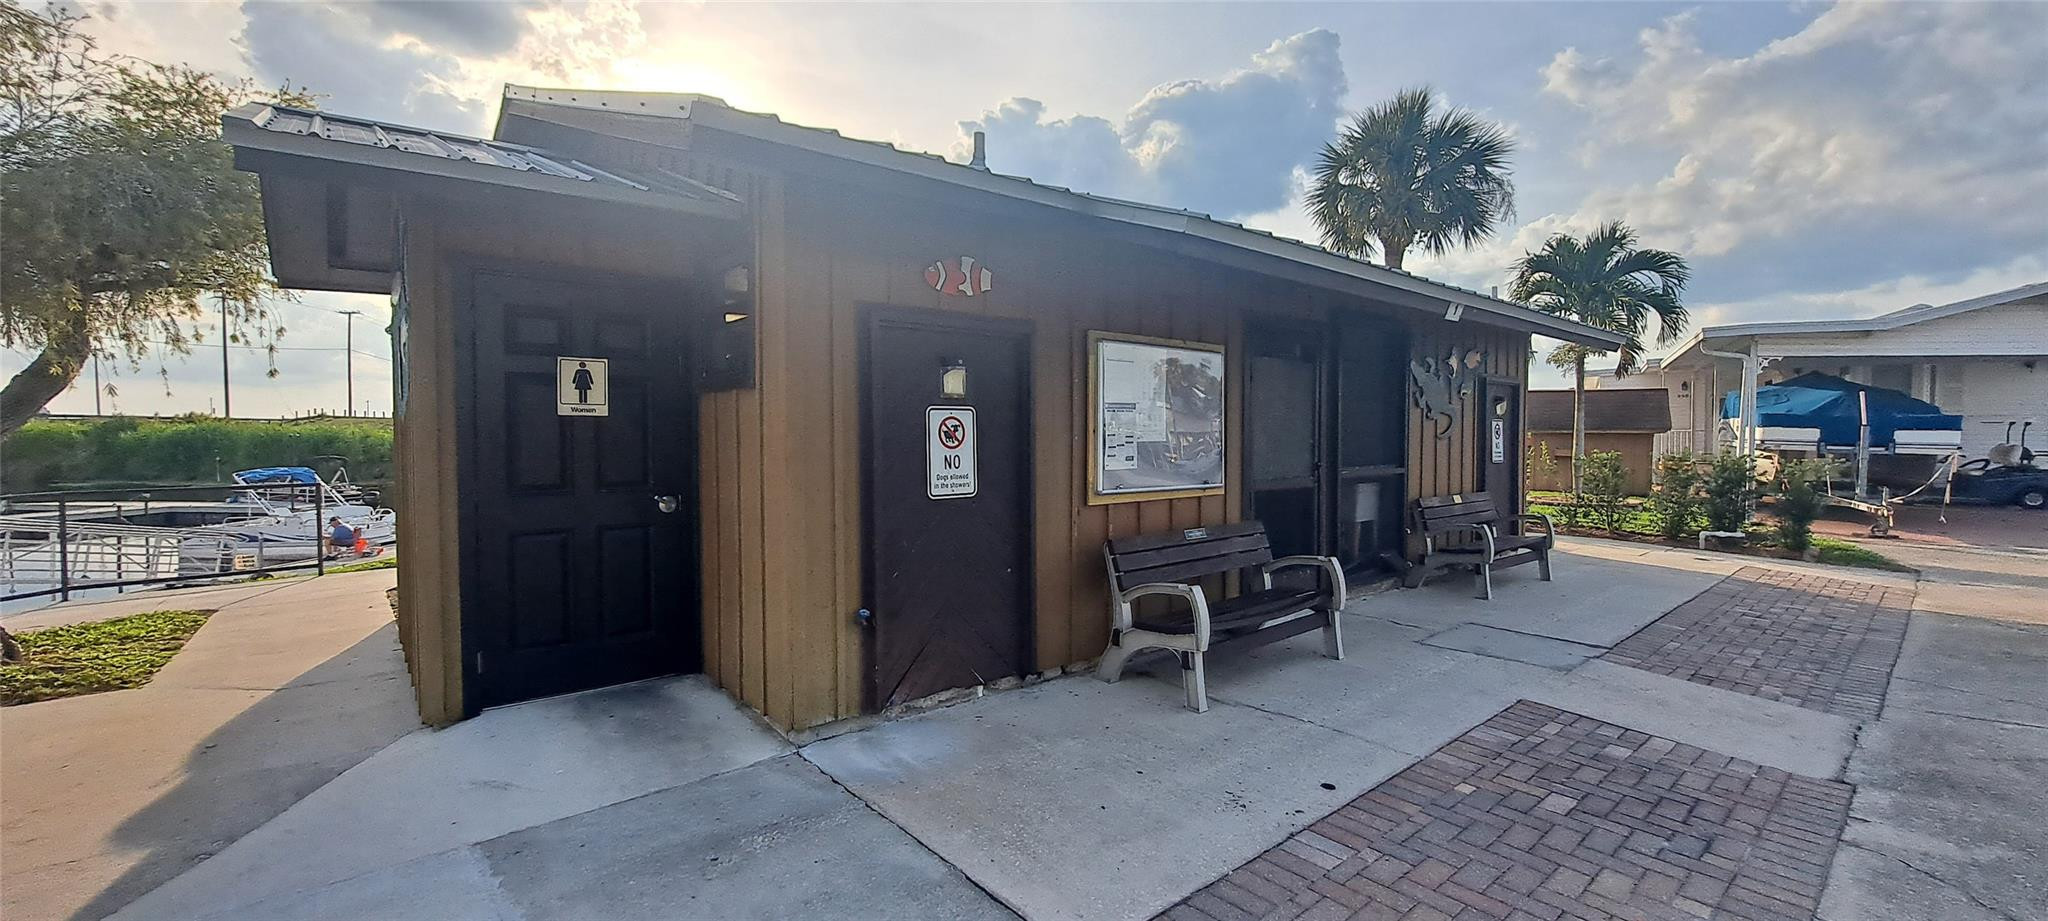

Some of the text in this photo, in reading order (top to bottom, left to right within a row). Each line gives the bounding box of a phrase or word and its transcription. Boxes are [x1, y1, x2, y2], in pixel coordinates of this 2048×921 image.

[570, 406, 597, 414] Women
[944, 454, 961, 470] NO
[936, 473, 949, 482] Dogs
